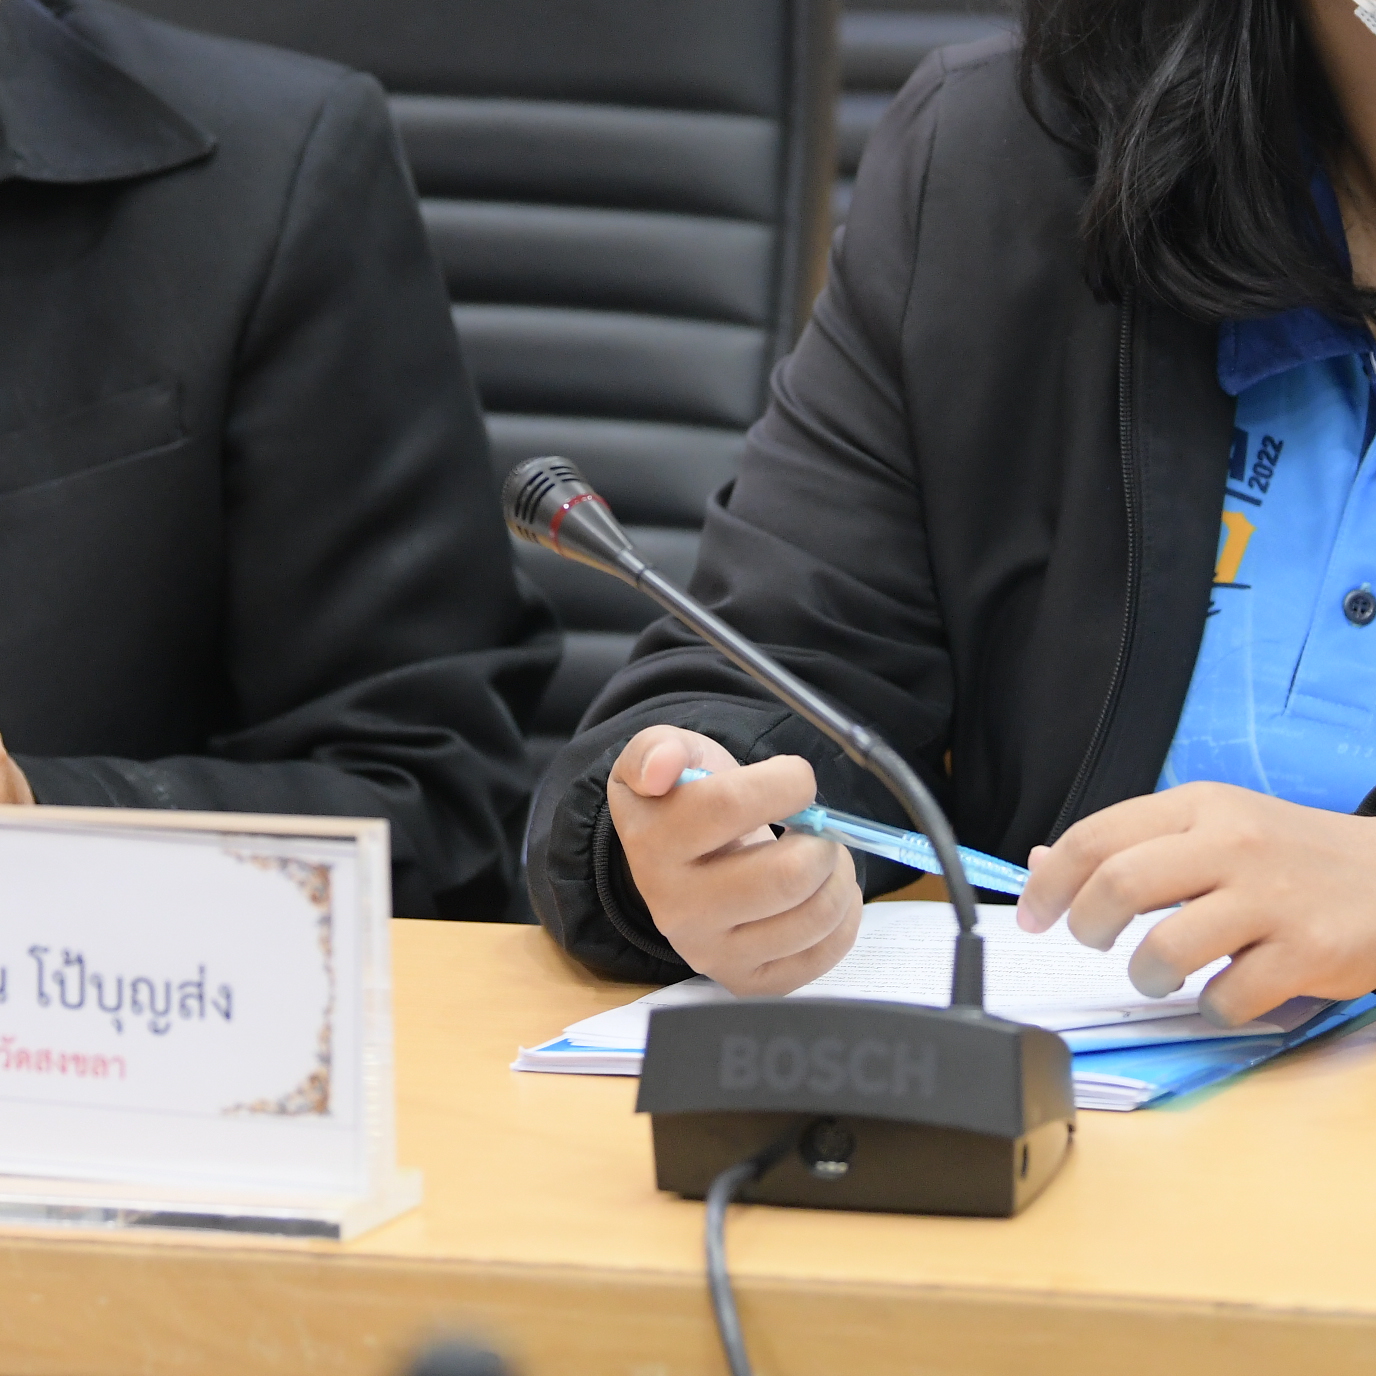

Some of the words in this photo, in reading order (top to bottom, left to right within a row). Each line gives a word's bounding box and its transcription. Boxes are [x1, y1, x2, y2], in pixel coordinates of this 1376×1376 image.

[1248, 435, 1284, 494] 2022
[27, 943, 233, 1036] โป้บุญส่ง
[722, 1034, 938, 1097] BOSCH
